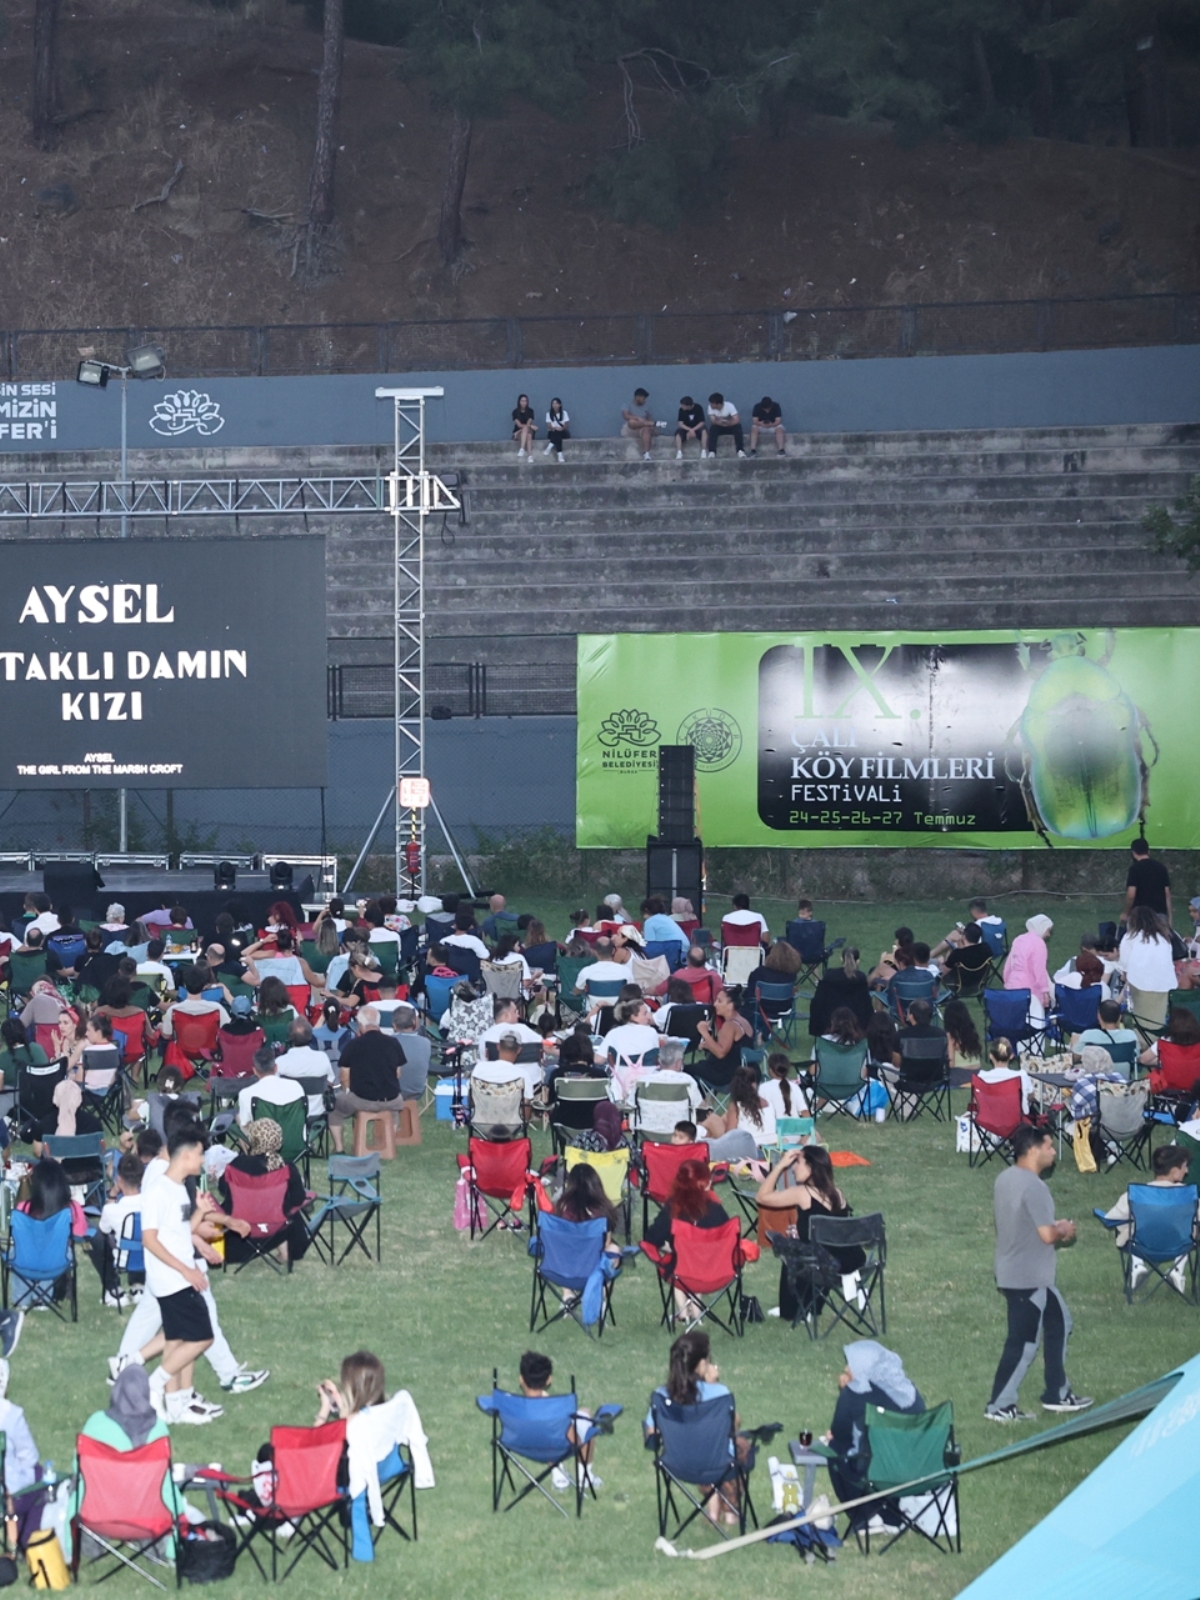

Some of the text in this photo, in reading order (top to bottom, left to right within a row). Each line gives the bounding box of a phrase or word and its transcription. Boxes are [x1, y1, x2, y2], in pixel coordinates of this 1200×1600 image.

[21, 382, 56, 396] SESİ
[18, 584, 175, 624] AYSEL
[127, 649, 247, 679] DAMIN
[61, 691, 142, 720] KIZI
[790, 726, 857, 754] ÇALI
[17, 764, 183, 775] THE GIRL FROM THE MARSH CROFT
[84, 753, 115, 763] AYSEL
[790, 751, 995, 780] KÖY FİLMLERİ
[789, 811, 976, 825] 24-25-26-27 Temmuz
